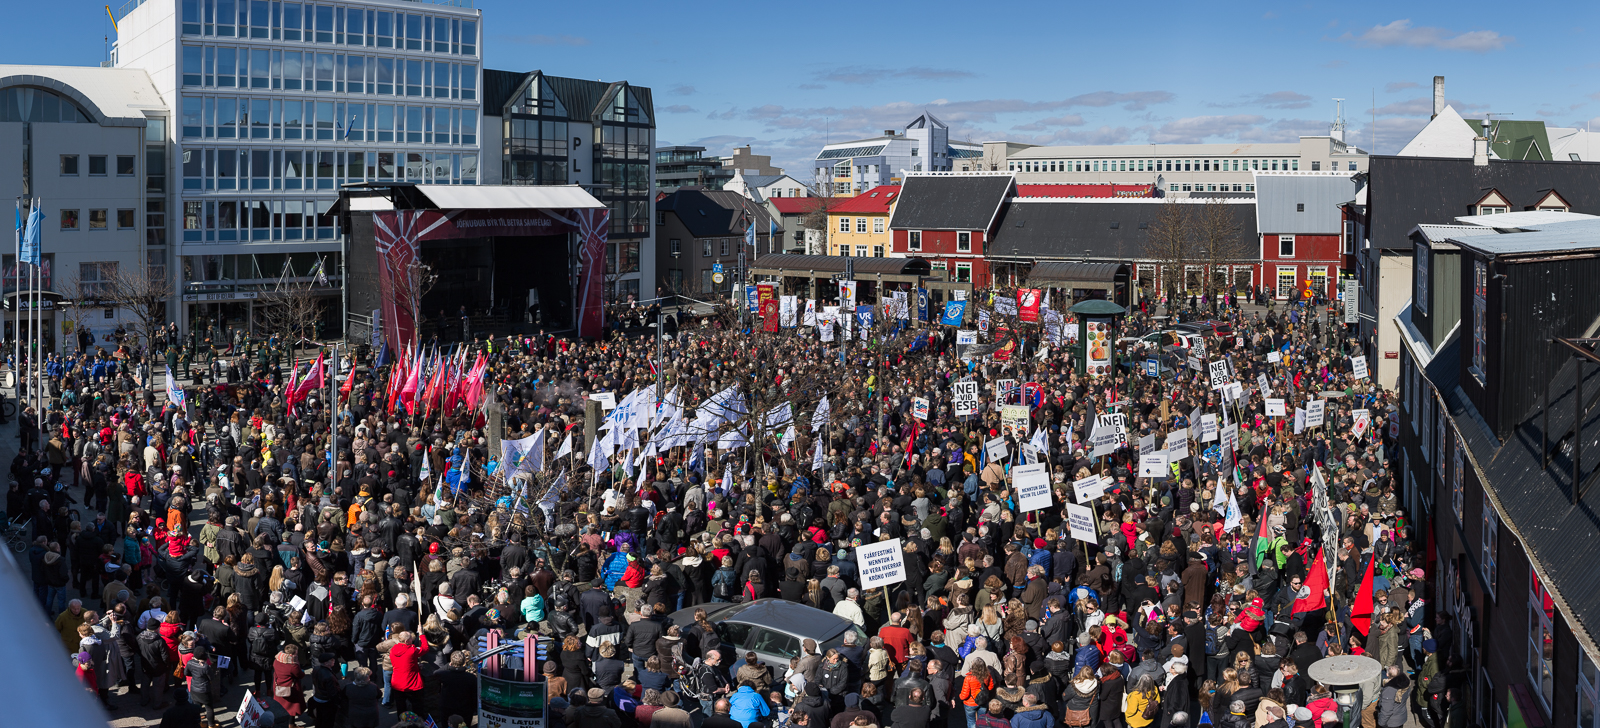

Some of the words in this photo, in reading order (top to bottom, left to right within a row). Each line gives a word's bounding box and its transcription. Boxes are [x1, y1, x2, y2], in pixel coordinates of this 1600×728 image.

[507, 218, 523, 227] BETRA
[859, 312, 872, 320] VR
[1193, 337, 1203, 345] NEI
[1210, 362, 1226, 372] NEI
[1213, 375, 1228, 386] ESB
[956, 383, 976, 394] NEI
[956, 400, 977, 411] ESB
[1103, 415, 1123, 426] NEI
[1022, 485, 1038, 493] MENNTUN
[864, 548, 892, 559] FJÁRFESTING
[892, 545, 896, 553] Í
[868, 556, 890, 566] MENNTUN
[882, 562, 902, 570] HVERRAR
[482, 712, 507, 724] LÆTUR
